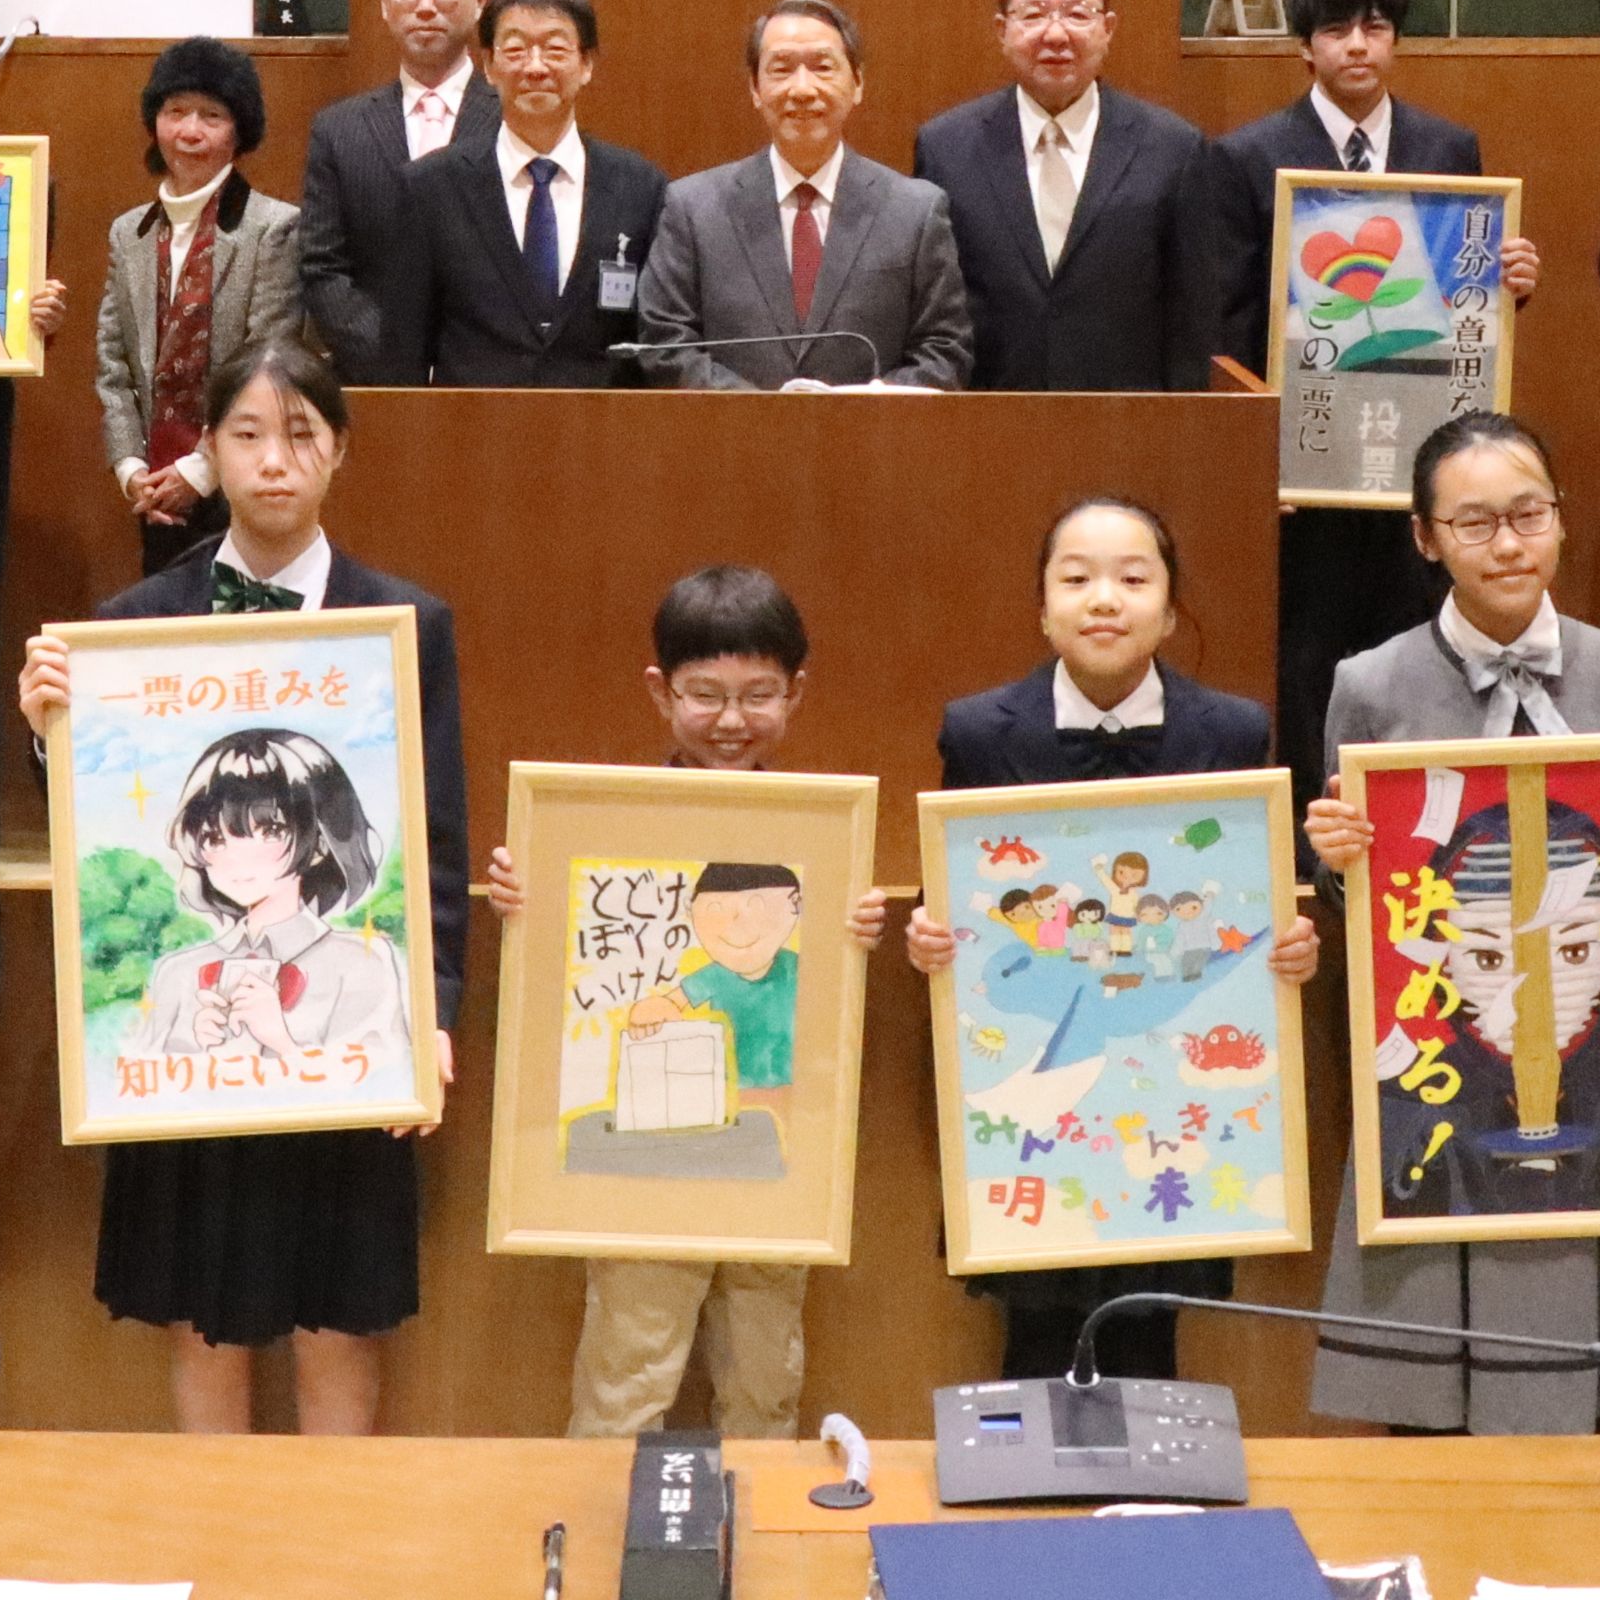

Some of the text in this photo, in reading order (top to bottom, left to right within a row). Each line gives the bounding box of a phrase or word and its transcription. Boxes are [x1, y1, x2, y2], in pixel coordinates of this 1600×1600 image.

[1299, 301, 1339, 453] この一票に
[1358, 400, 1401, 493] 投票
[101, 664, 350, 718] 一票の重みを
[588, 870, 687, 922] とどけ
[577, 923, 692, 961] ぼくの
[573, 956, 679, 1011] いけん
[114, 1042, 371, 1098] 知りにいこう
